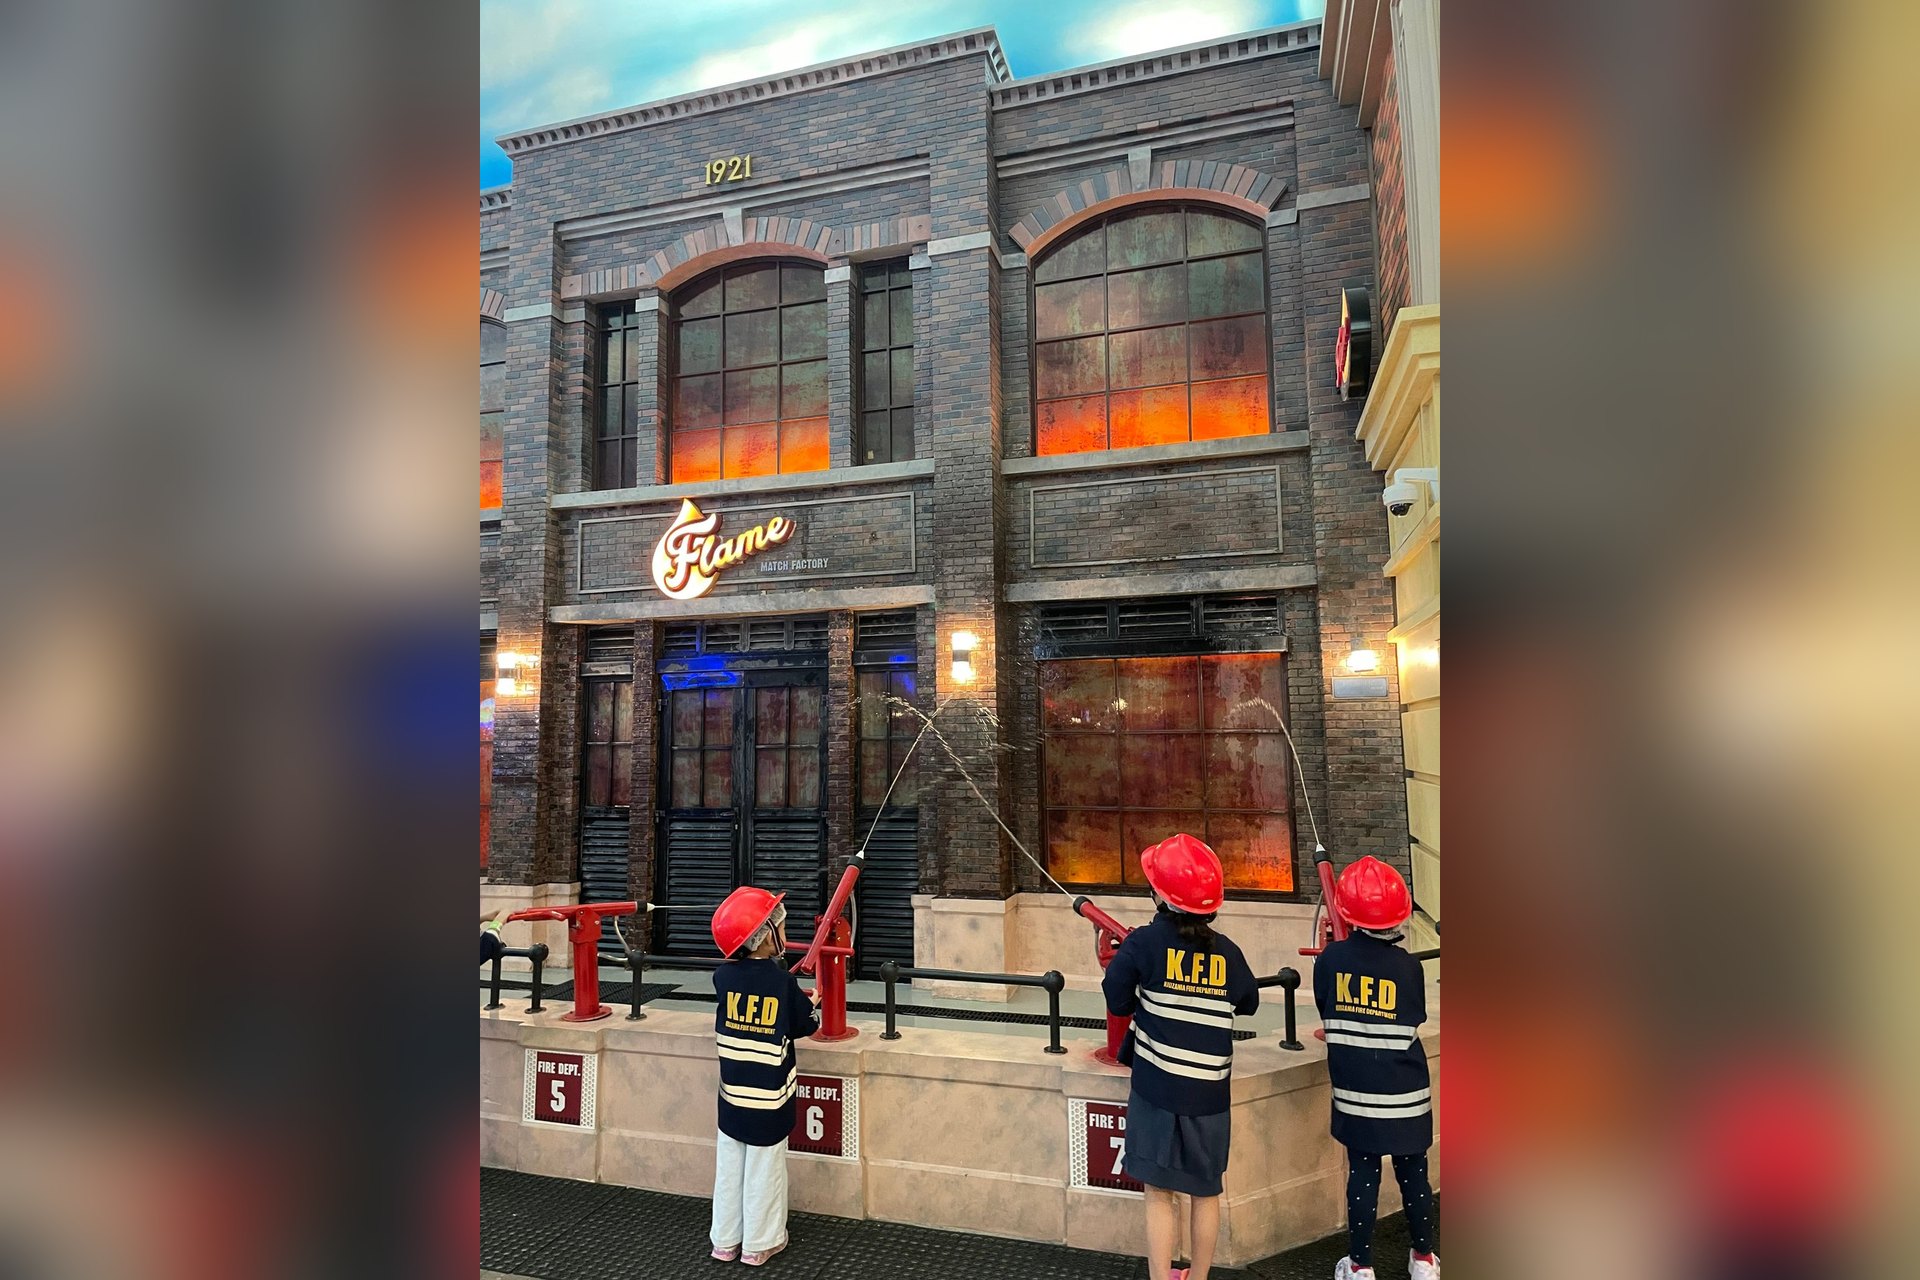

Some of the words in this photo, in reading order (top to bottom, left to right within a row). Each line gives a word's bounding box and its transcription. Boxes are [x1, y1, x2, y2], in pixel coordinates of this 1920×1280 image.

[705, 154, 752, 185] 1921
[665, 513, 794, 589] Flame
[761, 560, 789, 572] MATCH
[791, 558, 829, 570] FACTORY
[1166, 947, 1227, 987] K.F.D
[726, 991, 779, 1026] K.F.D
[1336, 972, 1397, 1011] K.F.D
[538, 1061, 556, 1074] FIRE
[558, 1062, 581, 1077] DEPT.
[550, 1079, 566, 1112] 5
[796, 1084, 811, 1099] IRE
[814, 1086, 841, 1101] DEPT.
[806, 1105, 824, 1141] 6
[1089, 1113, 1114, 1129] FIRE
[1110, 1136, 1126, 1175] 7
